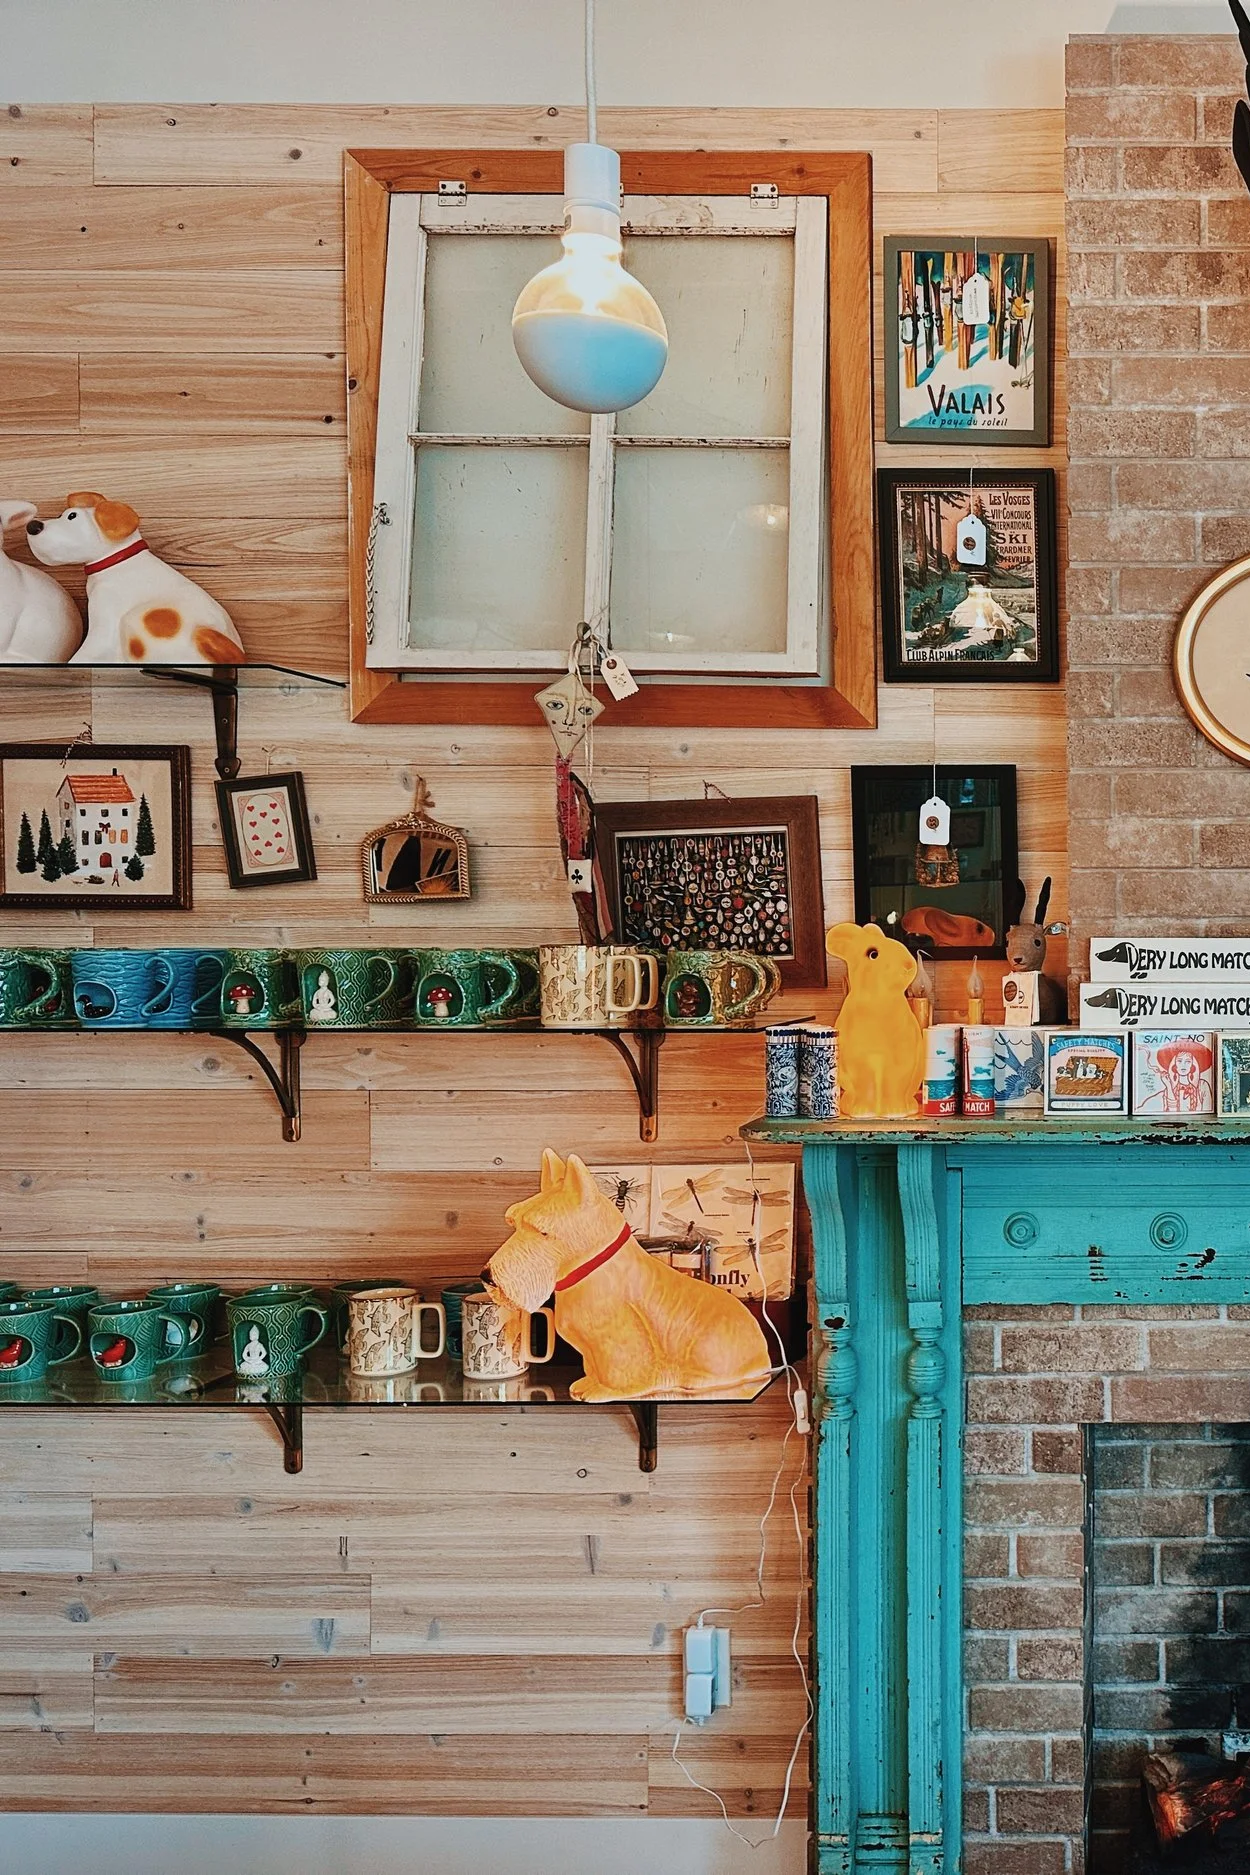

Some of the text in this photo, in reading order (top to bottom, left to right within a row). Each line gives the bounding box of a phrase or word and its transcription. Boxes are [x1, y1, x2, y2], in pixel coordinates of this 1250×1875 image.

[927, 384, 1006, 417] VALAIS
[928, 416, 1008, 428] le pays du soleil
[989, 490, 1031, 506] LES VOSGES
[1002, 507, 1032, 520] CONCOURS
[995, 532, 1027, 544] SKI
[906, 649, 929, 661] CLUB
[929, 649, 954, 661] ALPIN
[1169, 951, 1208, 970] LONG
[1160, 996, 1200, 1015] LONG
[1056, 1037, 1116, 1050] SAFETY MATCHES
[964, 1101, 990, 1112] MATCH
